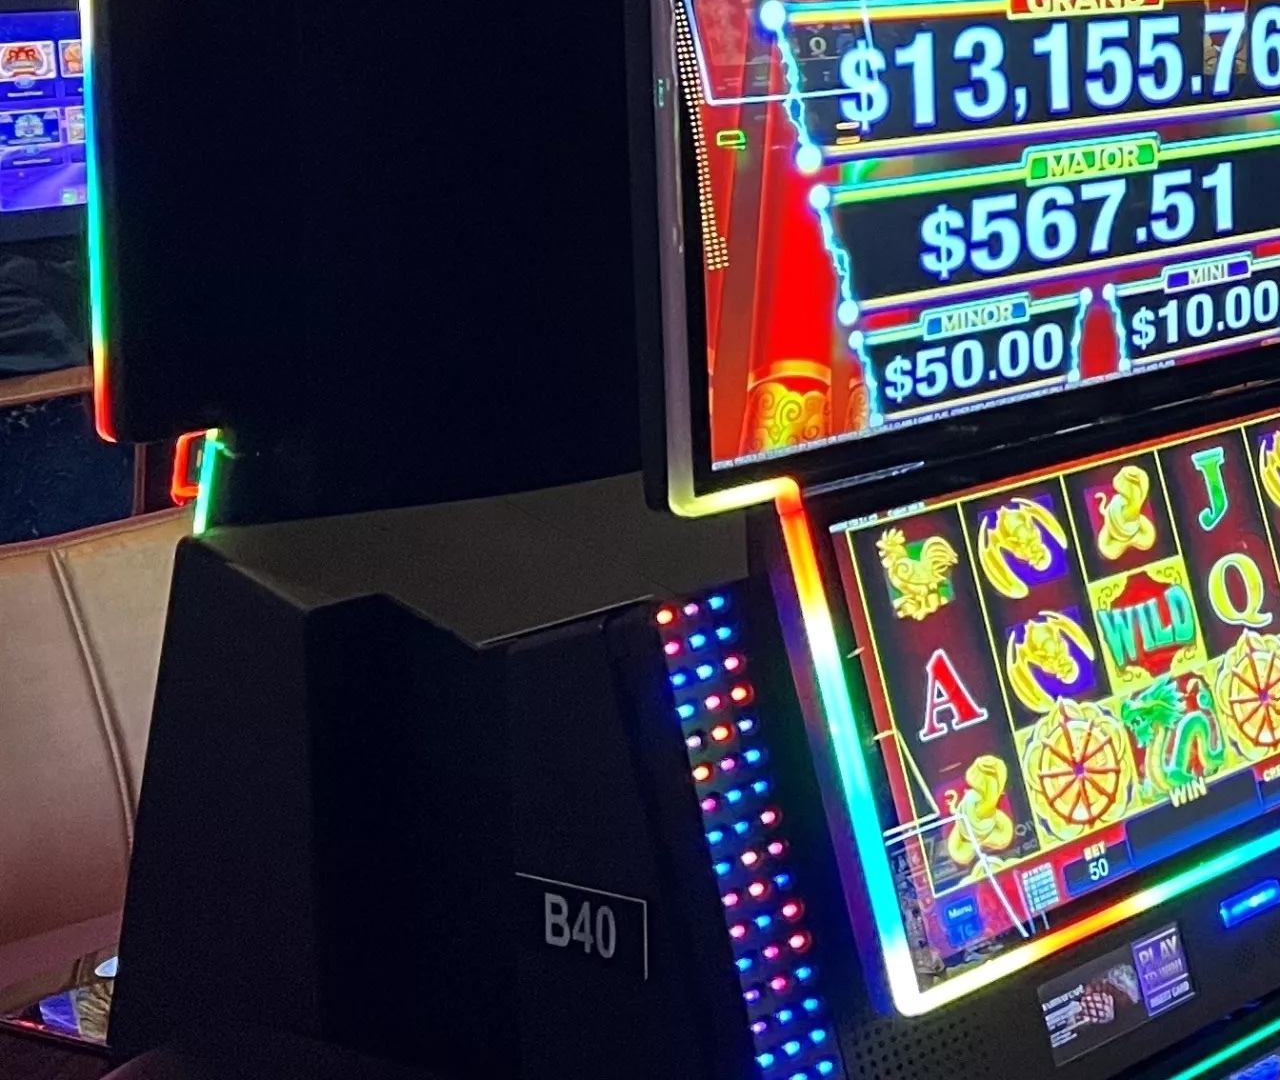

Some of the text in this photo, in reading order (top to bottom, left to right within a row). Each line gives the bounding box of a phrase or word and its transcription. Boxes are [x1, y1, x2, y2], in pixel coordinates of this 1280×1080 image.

[1045, 143, 1140, 180] MAJOR
[920, 160, 1237, 282] $567.51
[1187, 263, 1230, 286] MINI
[940, 300, 1015, 334] MINOR
[1132, 279, 1280, 350] $10.00
[884, 320, 1064, 404] $50.00
[1191, 446, 1228, 531] J
[1208, 553, 1273, 628] Q
[1097, 583, 1196, 668] WILD
[919, 648, 988, 742] A
[1172, 775, 1207, 809] WIN
[1088, 858, 1109, 881] 50
[545, 892, 617, 959] B40
[947, 903, 973, 919] Menu
[1138, 935, 1178, 965] PLAY
